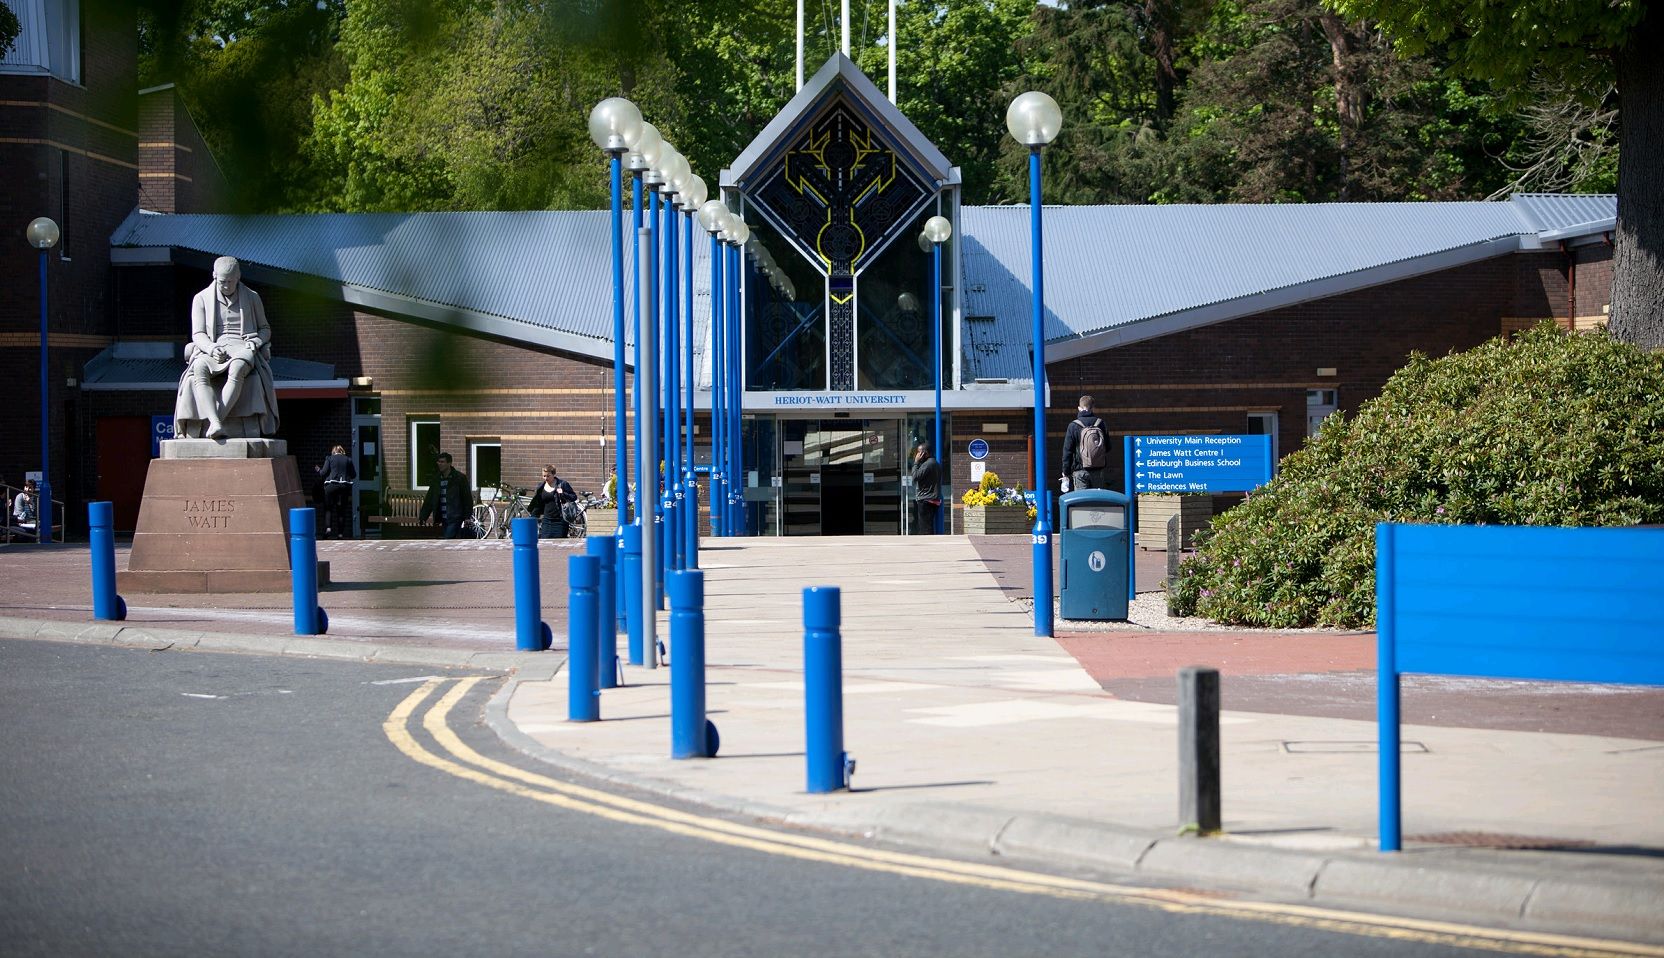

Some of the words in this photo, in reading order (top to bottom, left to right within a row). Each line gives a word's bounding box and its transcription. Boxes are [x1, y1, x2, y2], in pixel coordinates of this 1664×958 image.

[775, 396, 842, 405] HERIOT-WATT
[845, 395, 906, 404] UNIVERSITY
[1146, 437, 1182, 446] University
[1204, 437, 1241, 446] Reception
[1149, 449, 1171, 457] James
[1173, 449, 1192, 457] Watt
[1193, 449, 1218, 457] Centre
[1146, 459, 1183, 468] Edinburgh
[1184, 459, 1215, 467] Business
[1216, 458, 1241, 466] School
[1147, 471, 1161, 479] The
[1163, 471, 1184, 479] Lawn
[1147, 482, 1187, 490] Residences
[1189, 482, 1207, 490] West
[183, 500, 236, 512] JAMES
[188, 516, 232, 529] WATT
